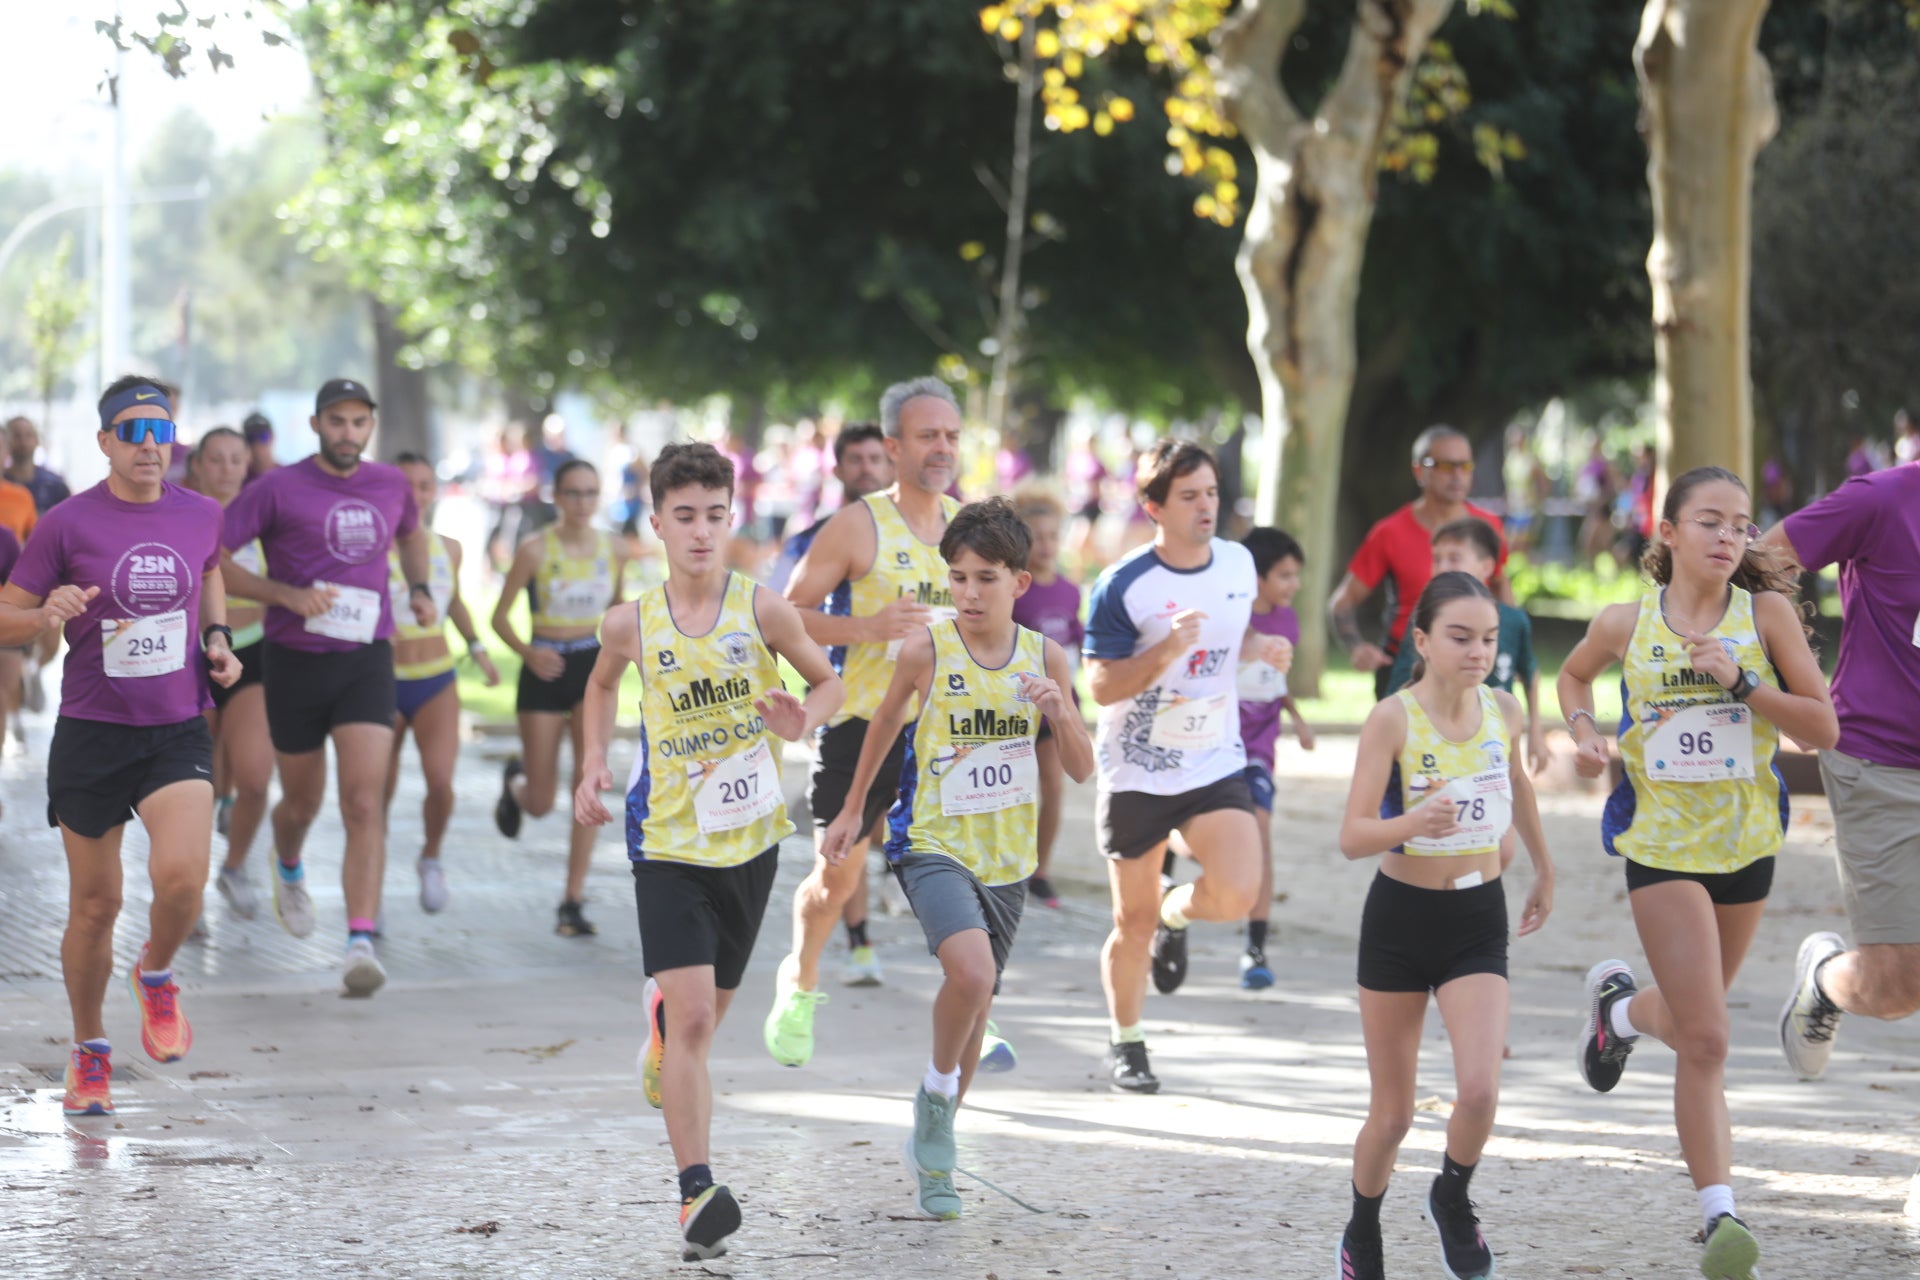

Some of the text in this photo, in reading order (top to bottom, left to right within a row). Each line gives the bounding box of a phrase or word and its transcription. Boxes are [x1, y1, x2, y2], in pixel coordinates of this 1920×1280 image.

[129, 555, 176, 574] 25N
[128, 635, 167, 657] 294
[658, 713, 768, 758] OLIMPO CÁD
[1183, 714, 1208, 733] 37
[1679, 731, 1714, 755] 96
[718, 772, 759, 804] 207
[968, 763, 1013, 789] 100
[1455, 797, 1485, 822] 78
